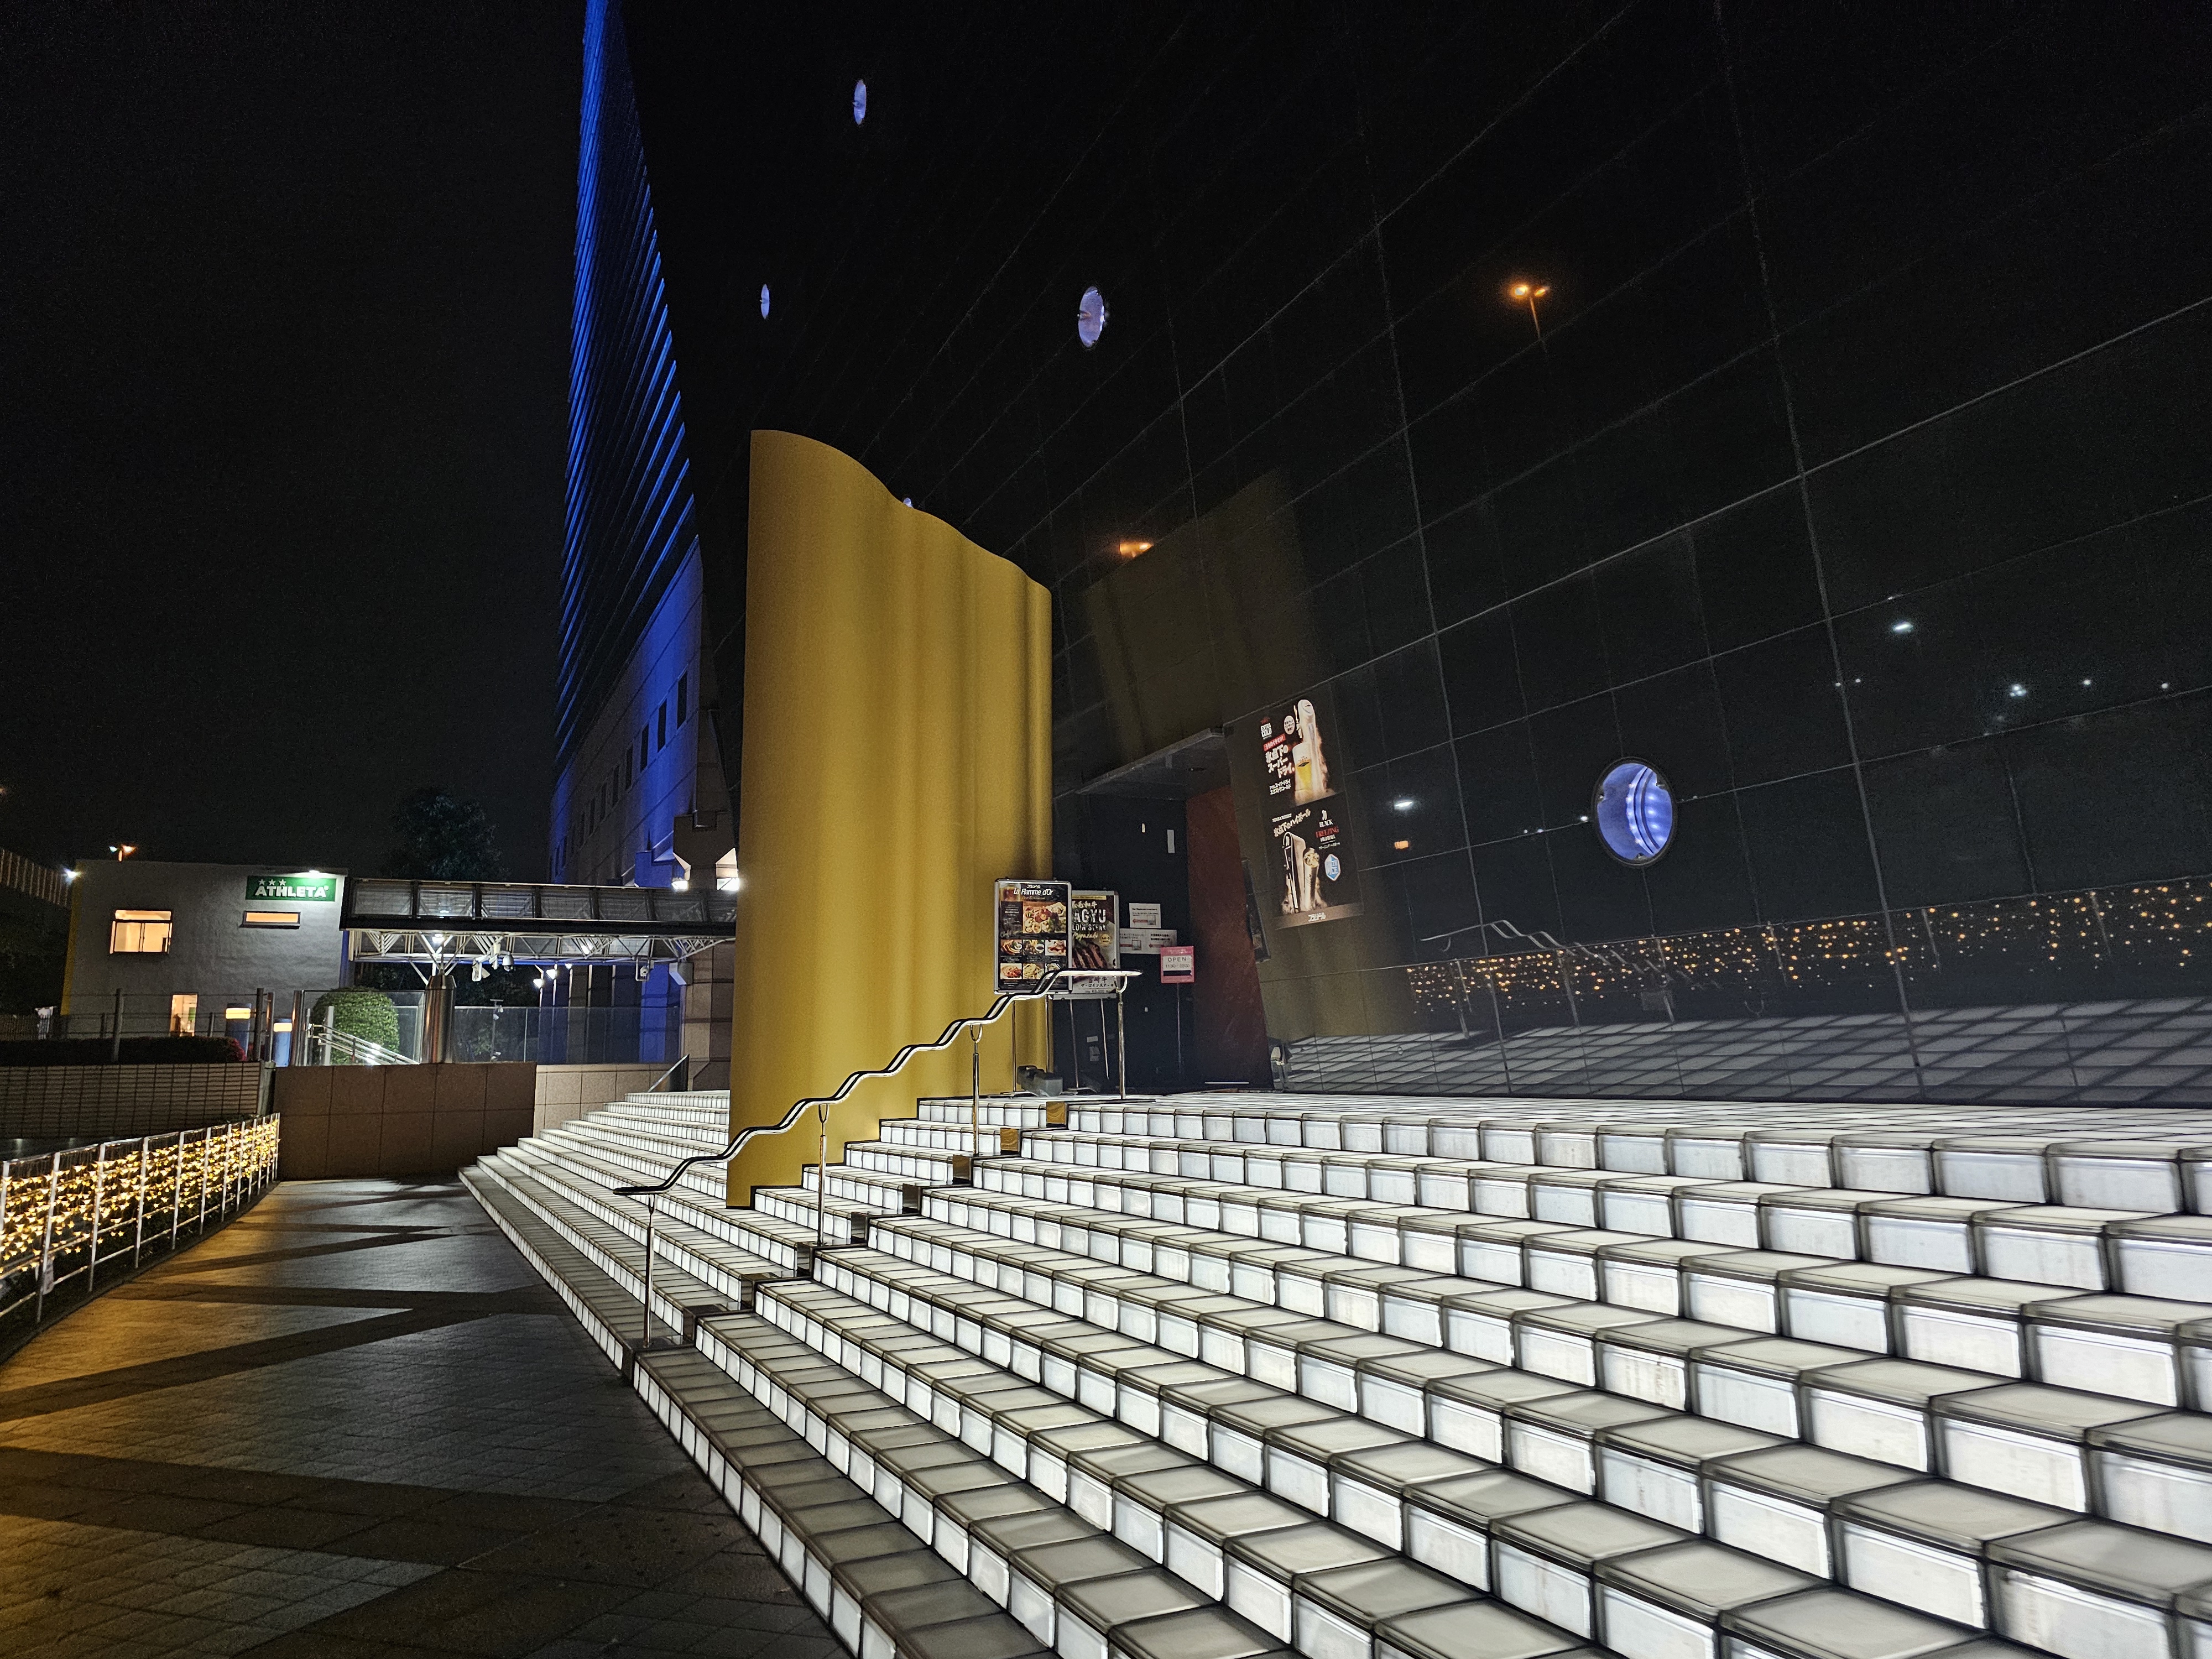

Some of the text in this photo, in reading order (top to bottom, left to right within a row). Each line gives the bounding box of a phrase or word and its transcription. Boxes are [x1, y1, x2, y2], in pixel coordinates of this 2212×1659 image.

[1265, 744, 1288, 763] 氷点下の
[1267, 757, 1288, 773] スーパー
[1274, 808, 1311, 837] 氷点下のハイボール
[255, 885, 327, 898] ATHLETA
[1073, 909, 1106, 923] AGYU
